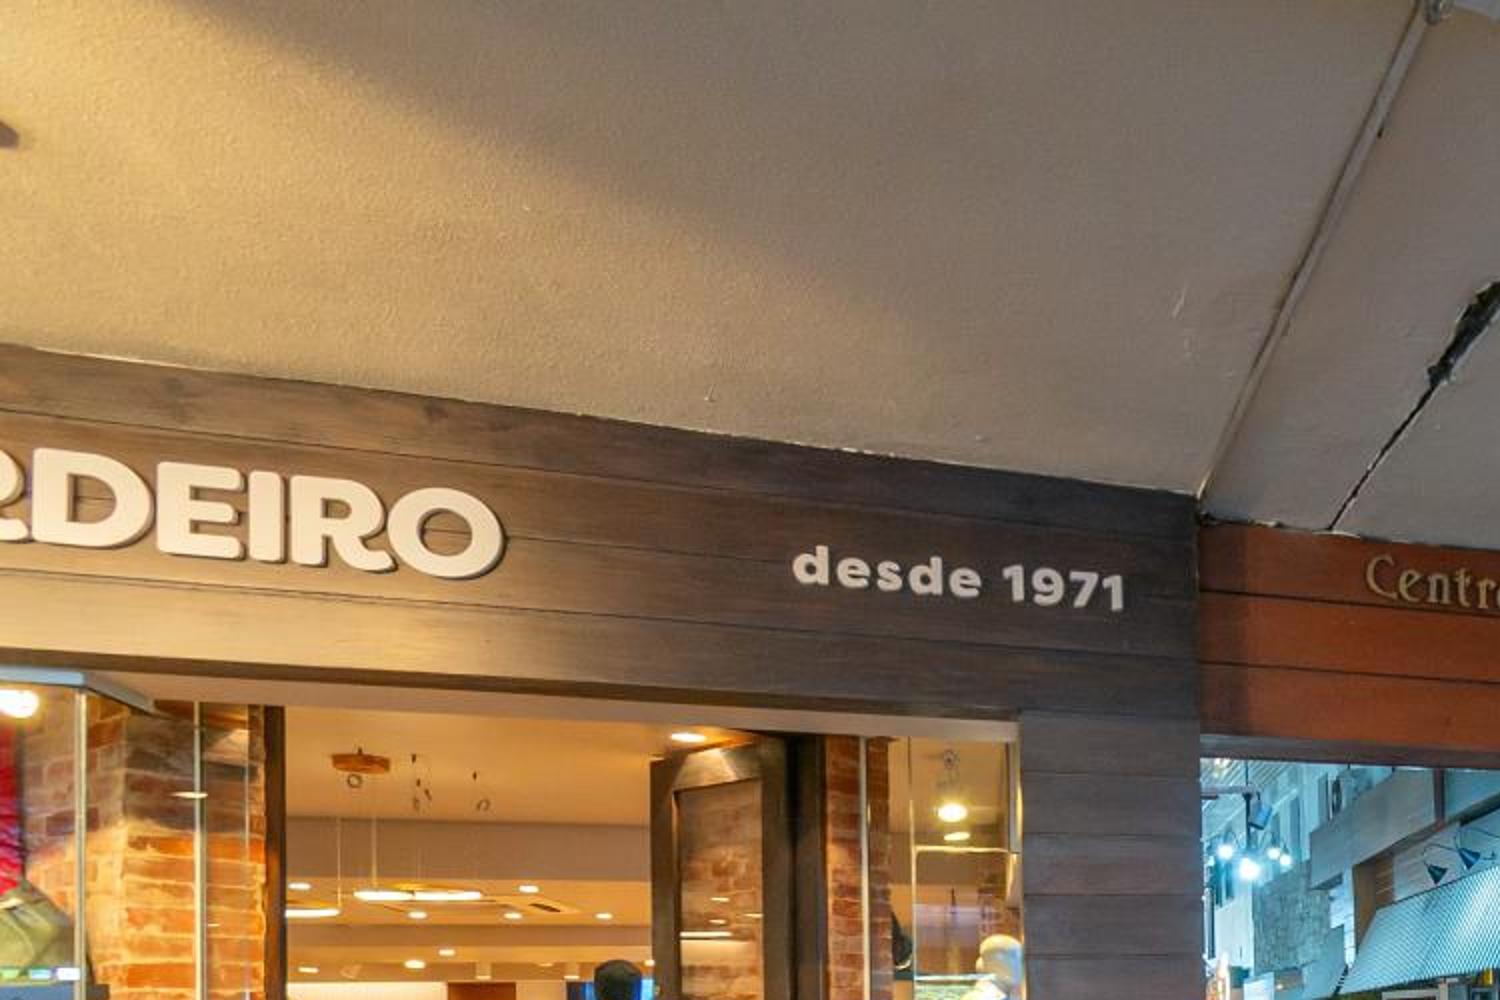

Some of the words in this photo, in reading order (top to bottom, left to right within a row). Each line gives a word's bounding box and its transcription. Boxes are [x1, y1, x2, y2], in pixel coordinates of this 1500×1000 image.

[0, 448, 506, 579] DEIRO
[792, 545, 982, 598] desde
[1002, 565, 1124, 612] 1971
